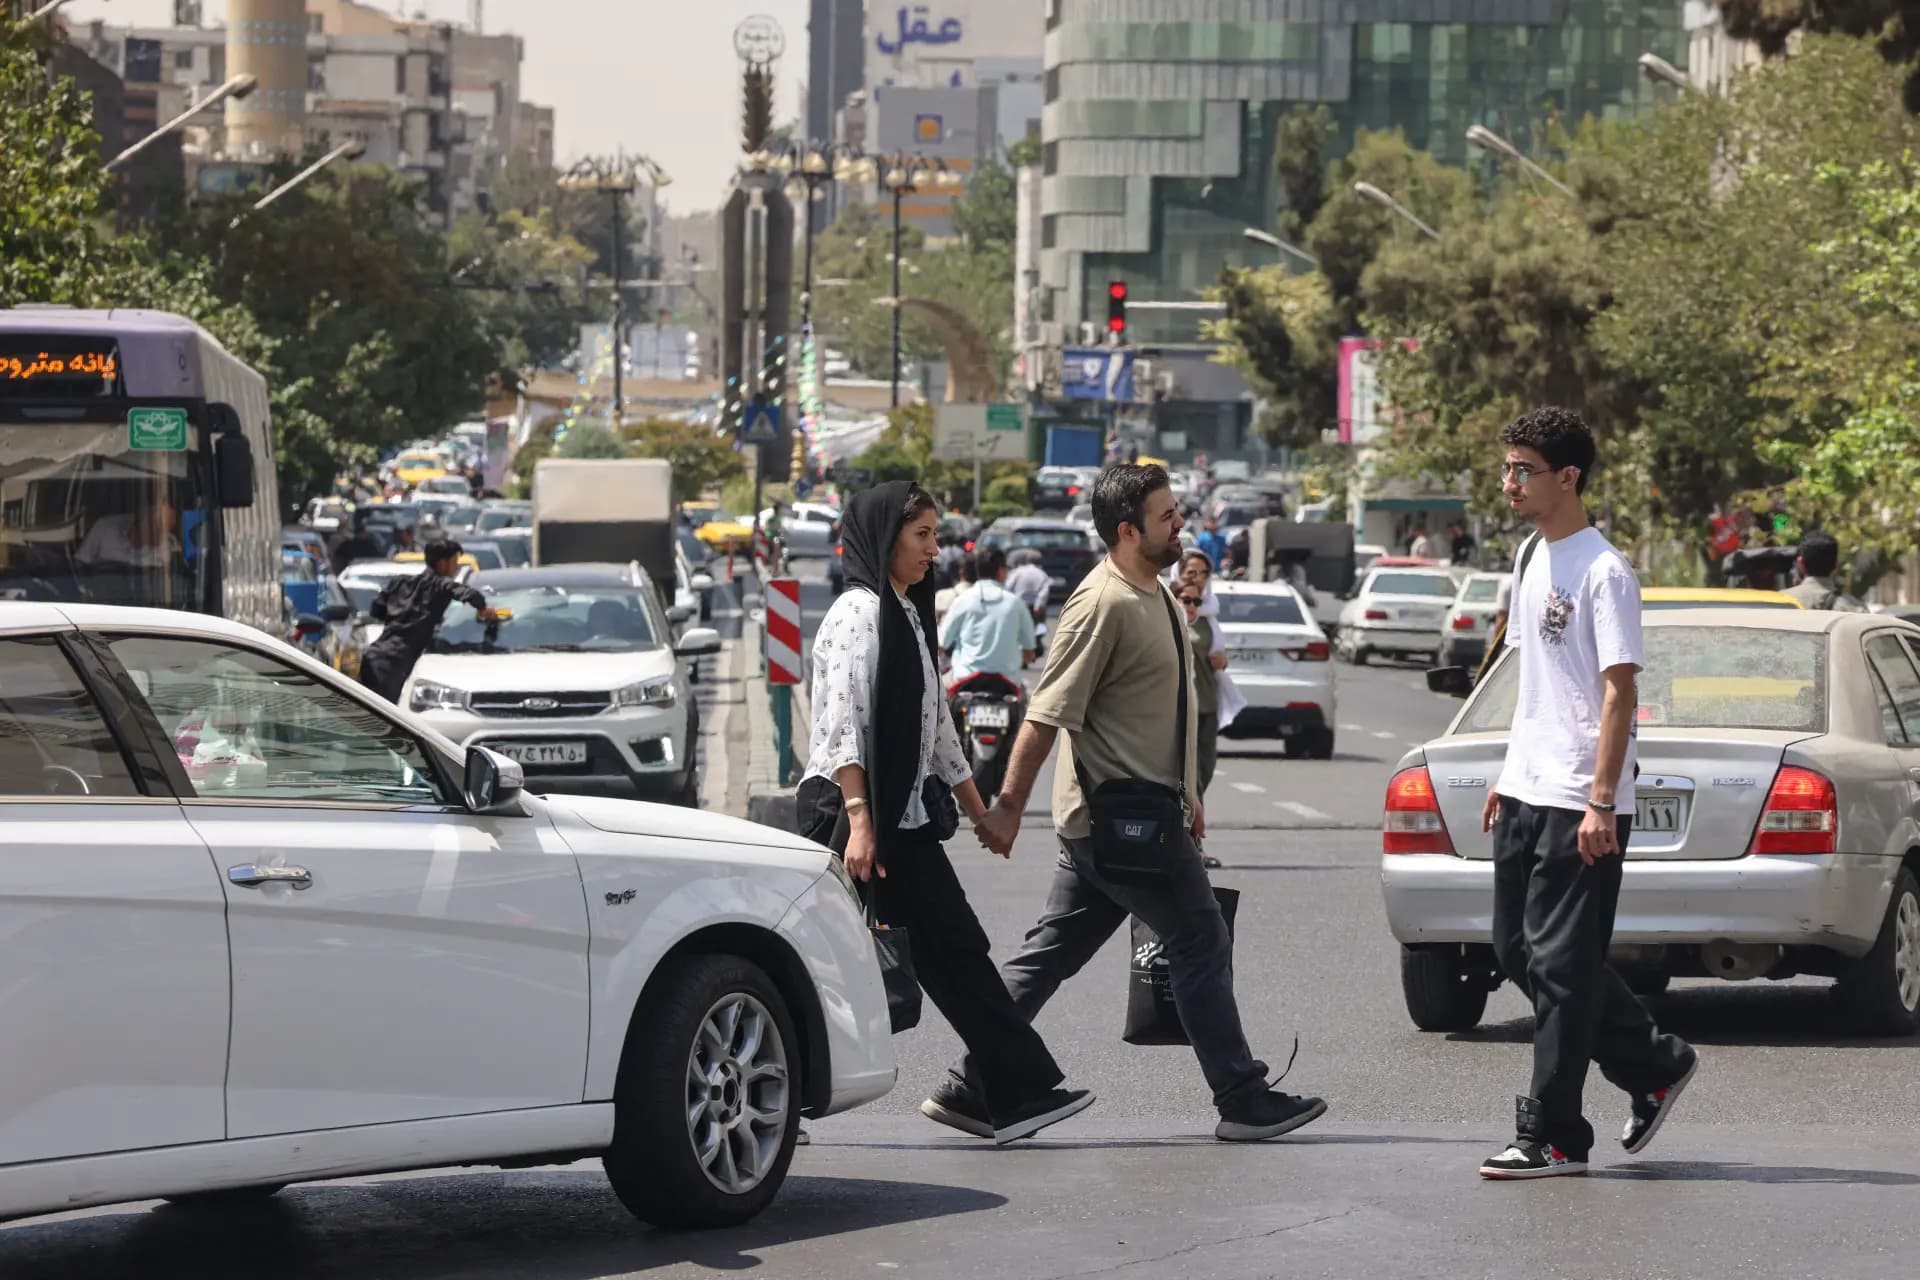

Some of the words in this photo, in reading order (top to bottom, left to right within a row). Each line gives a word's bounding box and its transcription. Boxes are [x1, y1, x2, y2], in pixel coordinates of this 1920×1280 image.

[876, 6, 962, 54] عقل
[1447, 776, 1487, 787] 323
[1649, 807, 1673, 828] ۱۱
[1124, 824, 1144, 837] CAT
